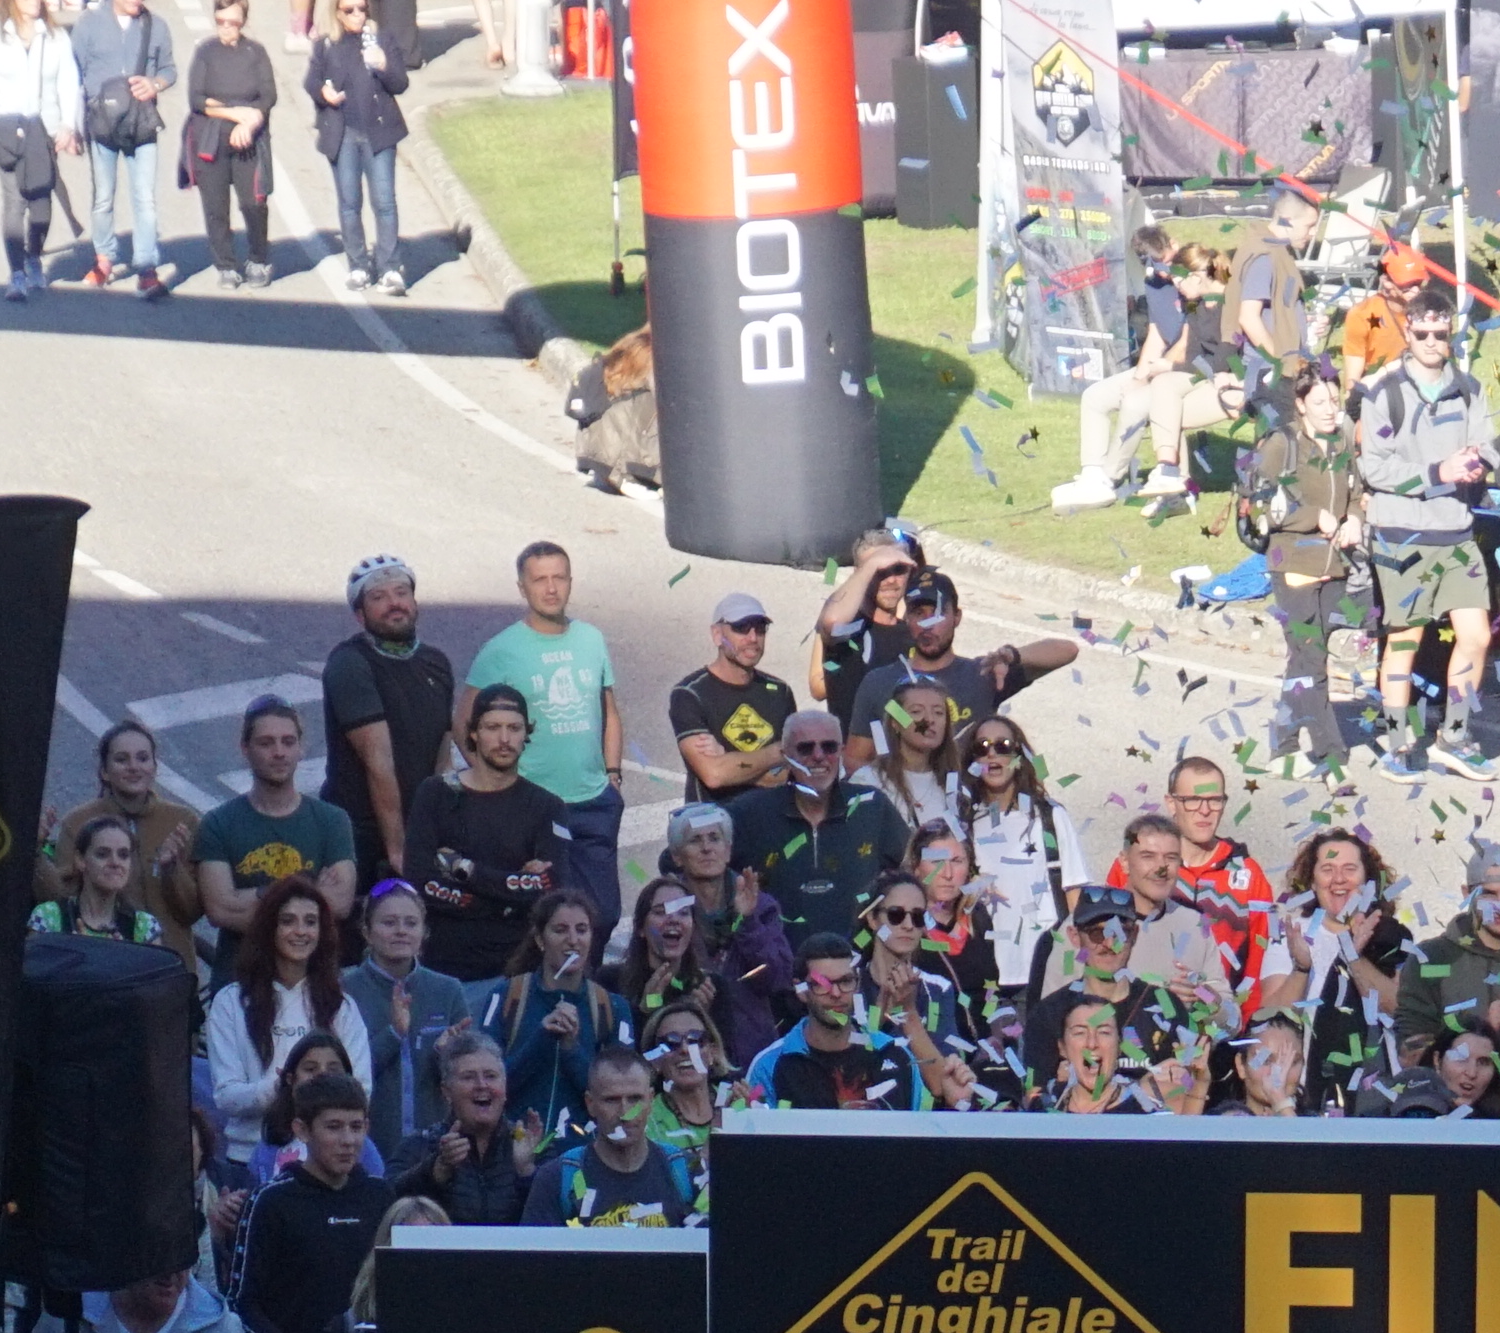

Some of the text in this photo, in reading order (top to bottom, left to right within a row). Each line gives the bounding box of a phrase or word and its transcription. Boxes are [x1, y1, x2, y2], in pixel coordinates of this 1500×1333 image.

[725, 0, 805, 384] BIOTEX
[928, 1230, 1025, 1260] Trail
[938, 1264, 1003, 1293] del
